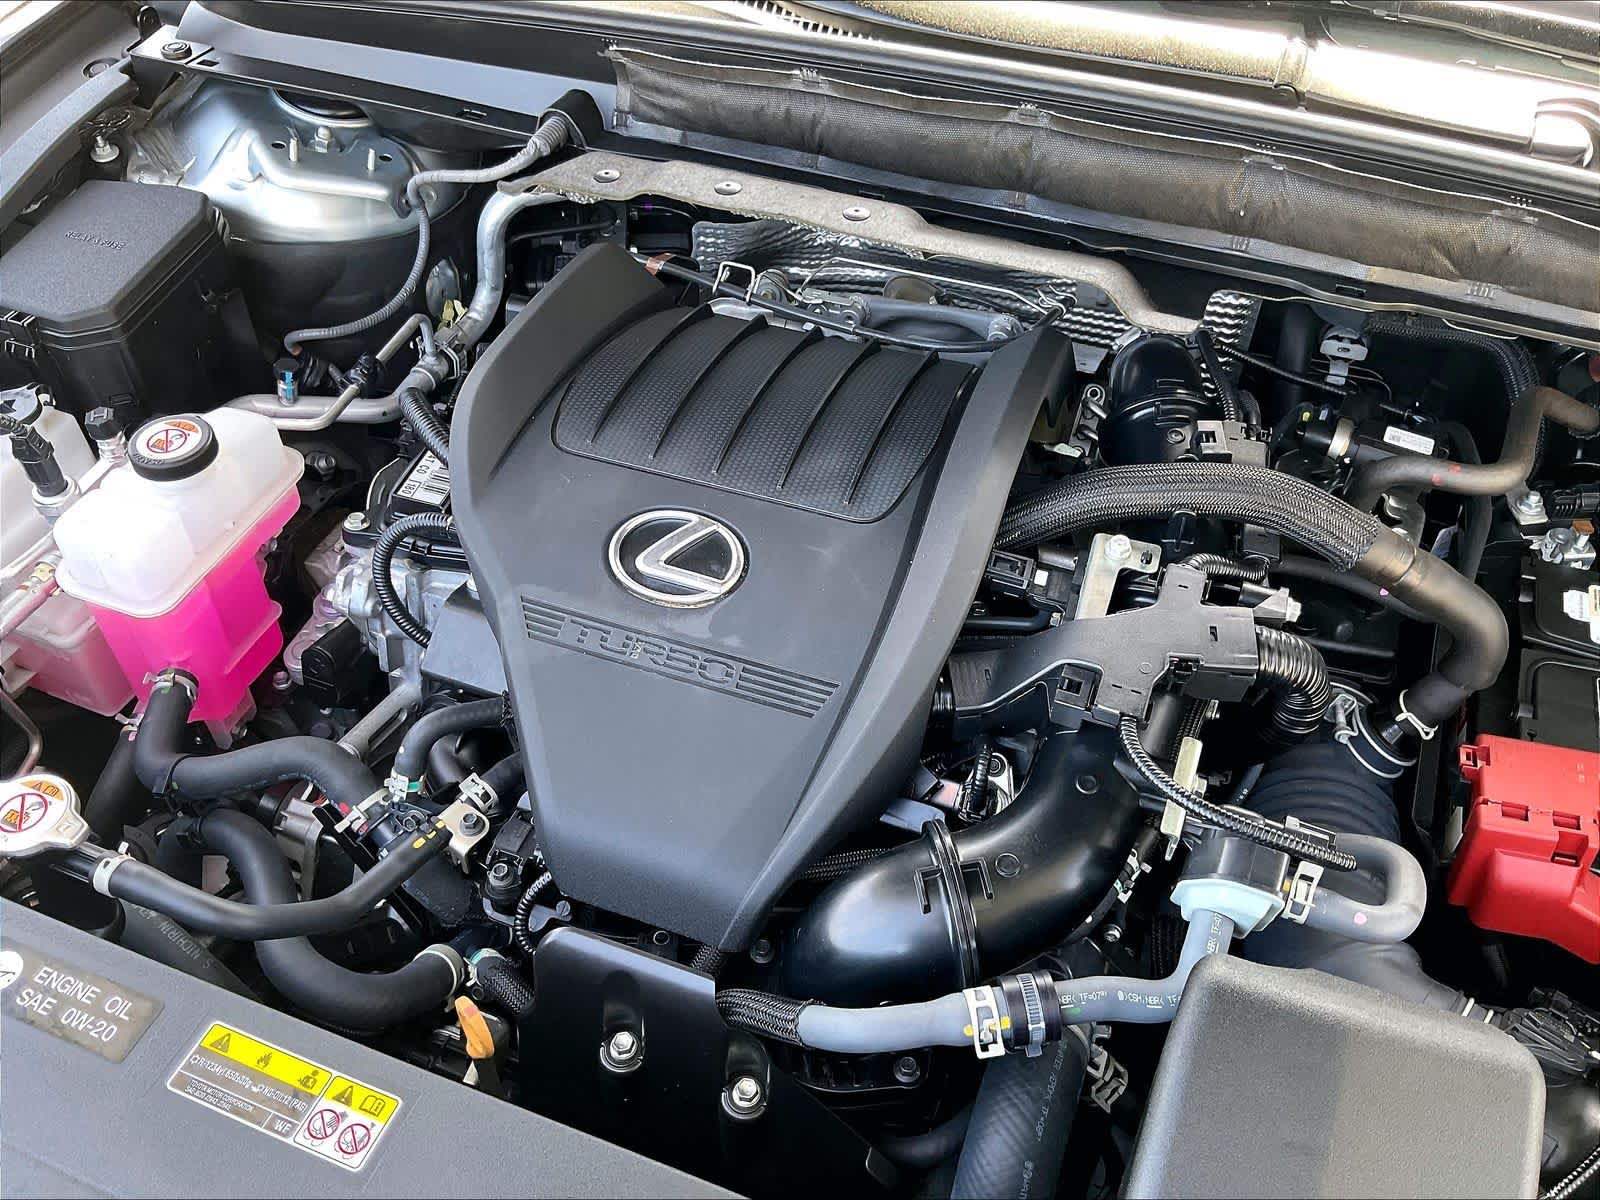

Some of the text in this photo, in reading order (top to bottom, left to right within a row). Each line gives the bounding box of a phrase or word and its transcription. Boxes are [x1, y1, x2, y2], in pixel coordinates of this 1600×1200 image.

[570, 619, 737, 684] TURBO
[16, 988, 118, 1042] SAE 0W-20
[33, 966, 133, 1021] ENGINE OIL
